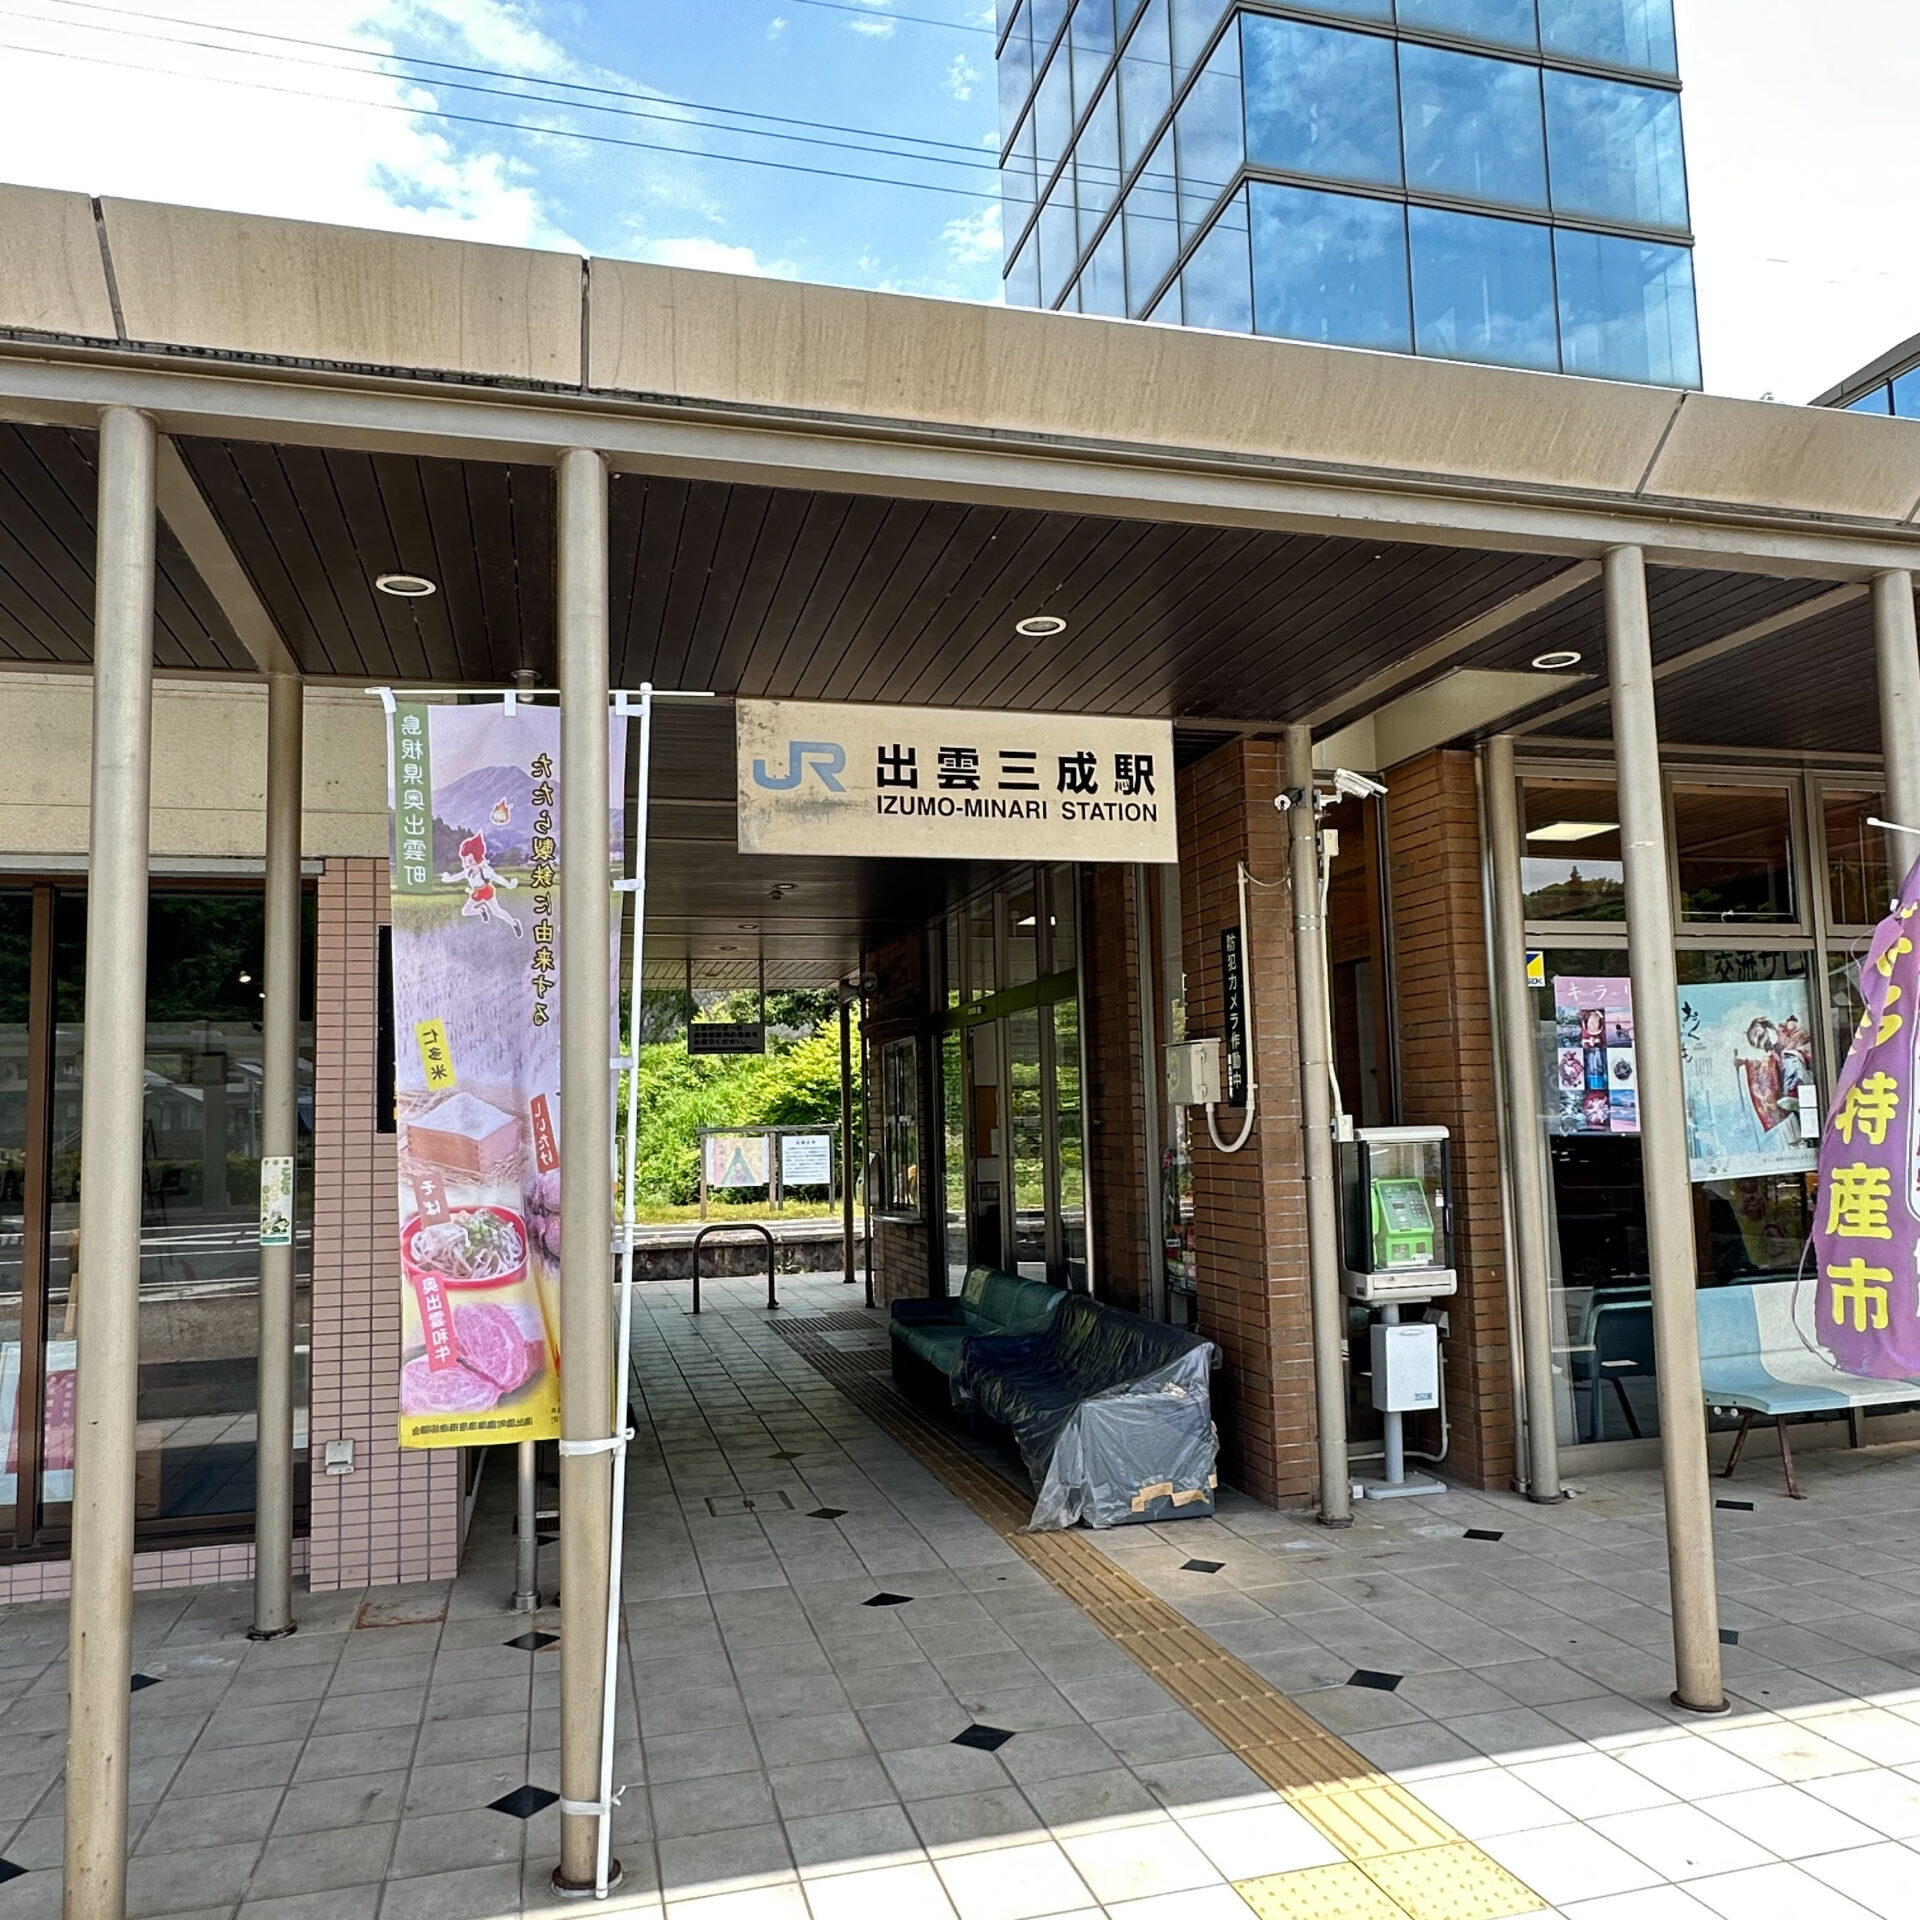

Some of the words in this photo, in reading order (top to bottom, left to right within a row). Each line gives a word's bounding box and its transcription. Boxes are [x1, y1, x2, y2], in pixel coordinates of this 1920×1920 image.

[753, 740, 846, 792] JR
[876, 743, 1156, 796] 出雲三成駅
[876, 794, 1048, 820] IZUMO-MINARI
[1061, 800, 1158, 822] STATION
[1226, 934, 1242, 1089] 防犯カメラ作動中
